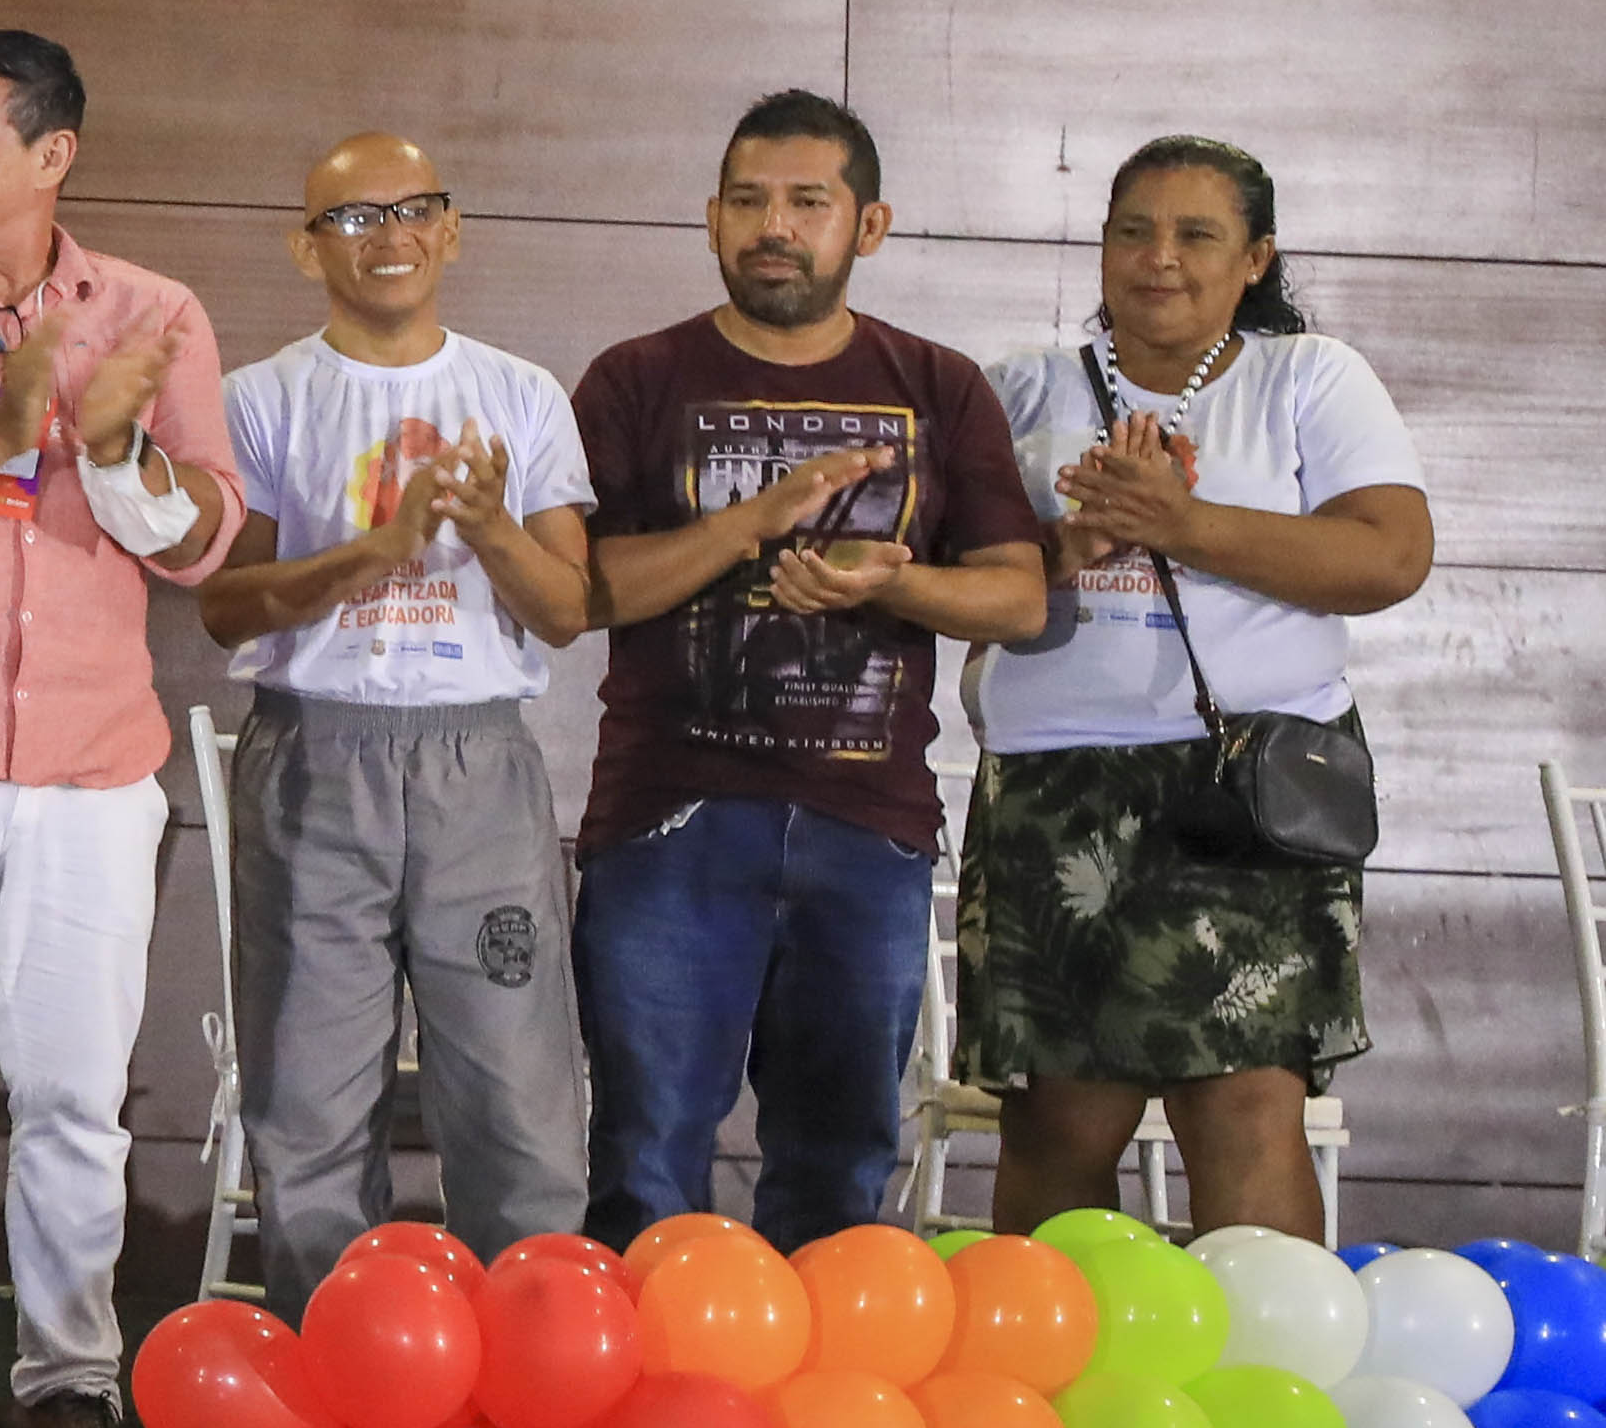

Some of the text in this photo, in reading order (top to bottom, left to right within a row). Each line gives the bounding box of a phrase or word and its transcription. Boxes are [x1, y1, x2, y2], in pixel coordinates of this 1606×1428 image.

[698, 414, 900, 437] LONDON
[343, 580, 458, 605] FAETIZADA
[339, 611, 351, 629] E
[690, 726, 883, 750] UNITED KINGDOM
